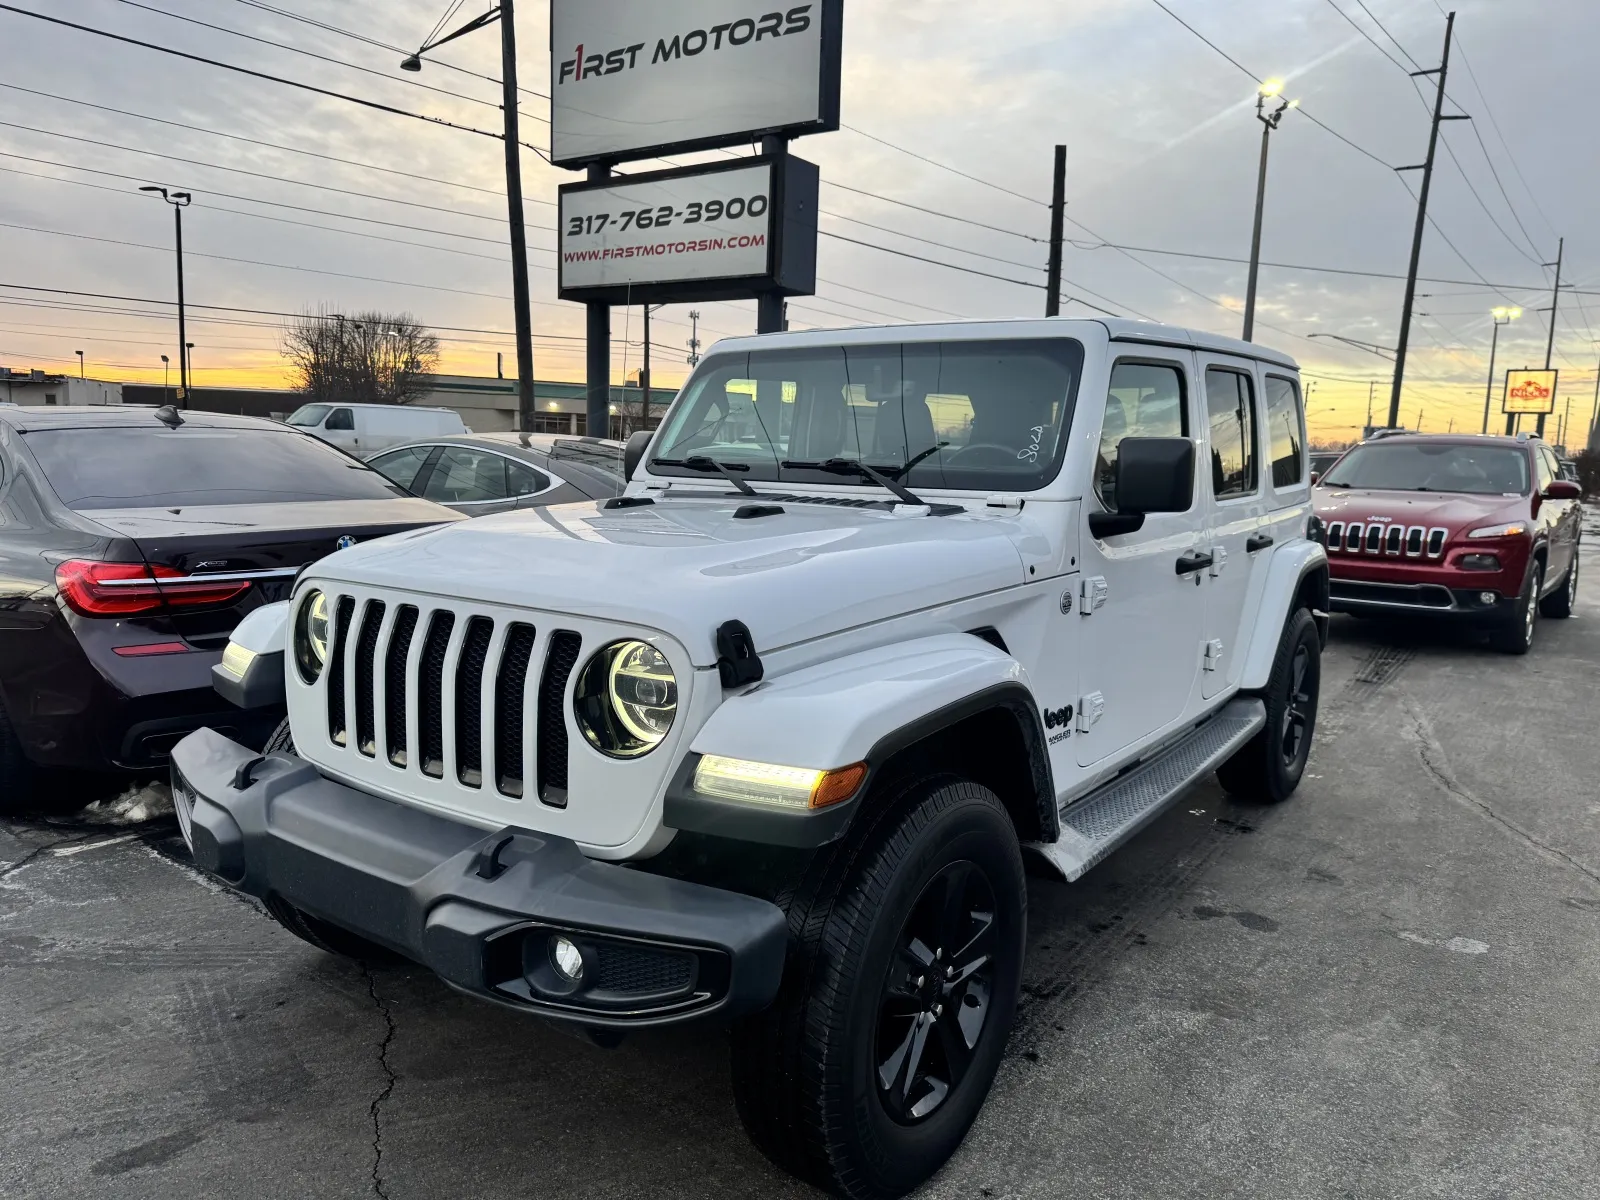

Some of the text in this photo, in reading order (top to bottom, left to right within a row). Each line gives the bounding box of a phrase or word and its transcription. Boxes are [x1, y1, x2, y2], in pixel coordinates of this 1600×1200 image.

[651, 4, 812, 64] MOTORS
[566, 194, 768, 237] 317-762-3900
[563, 233, 765, 263] WWW.FIRSTMOTORSIN.COM
